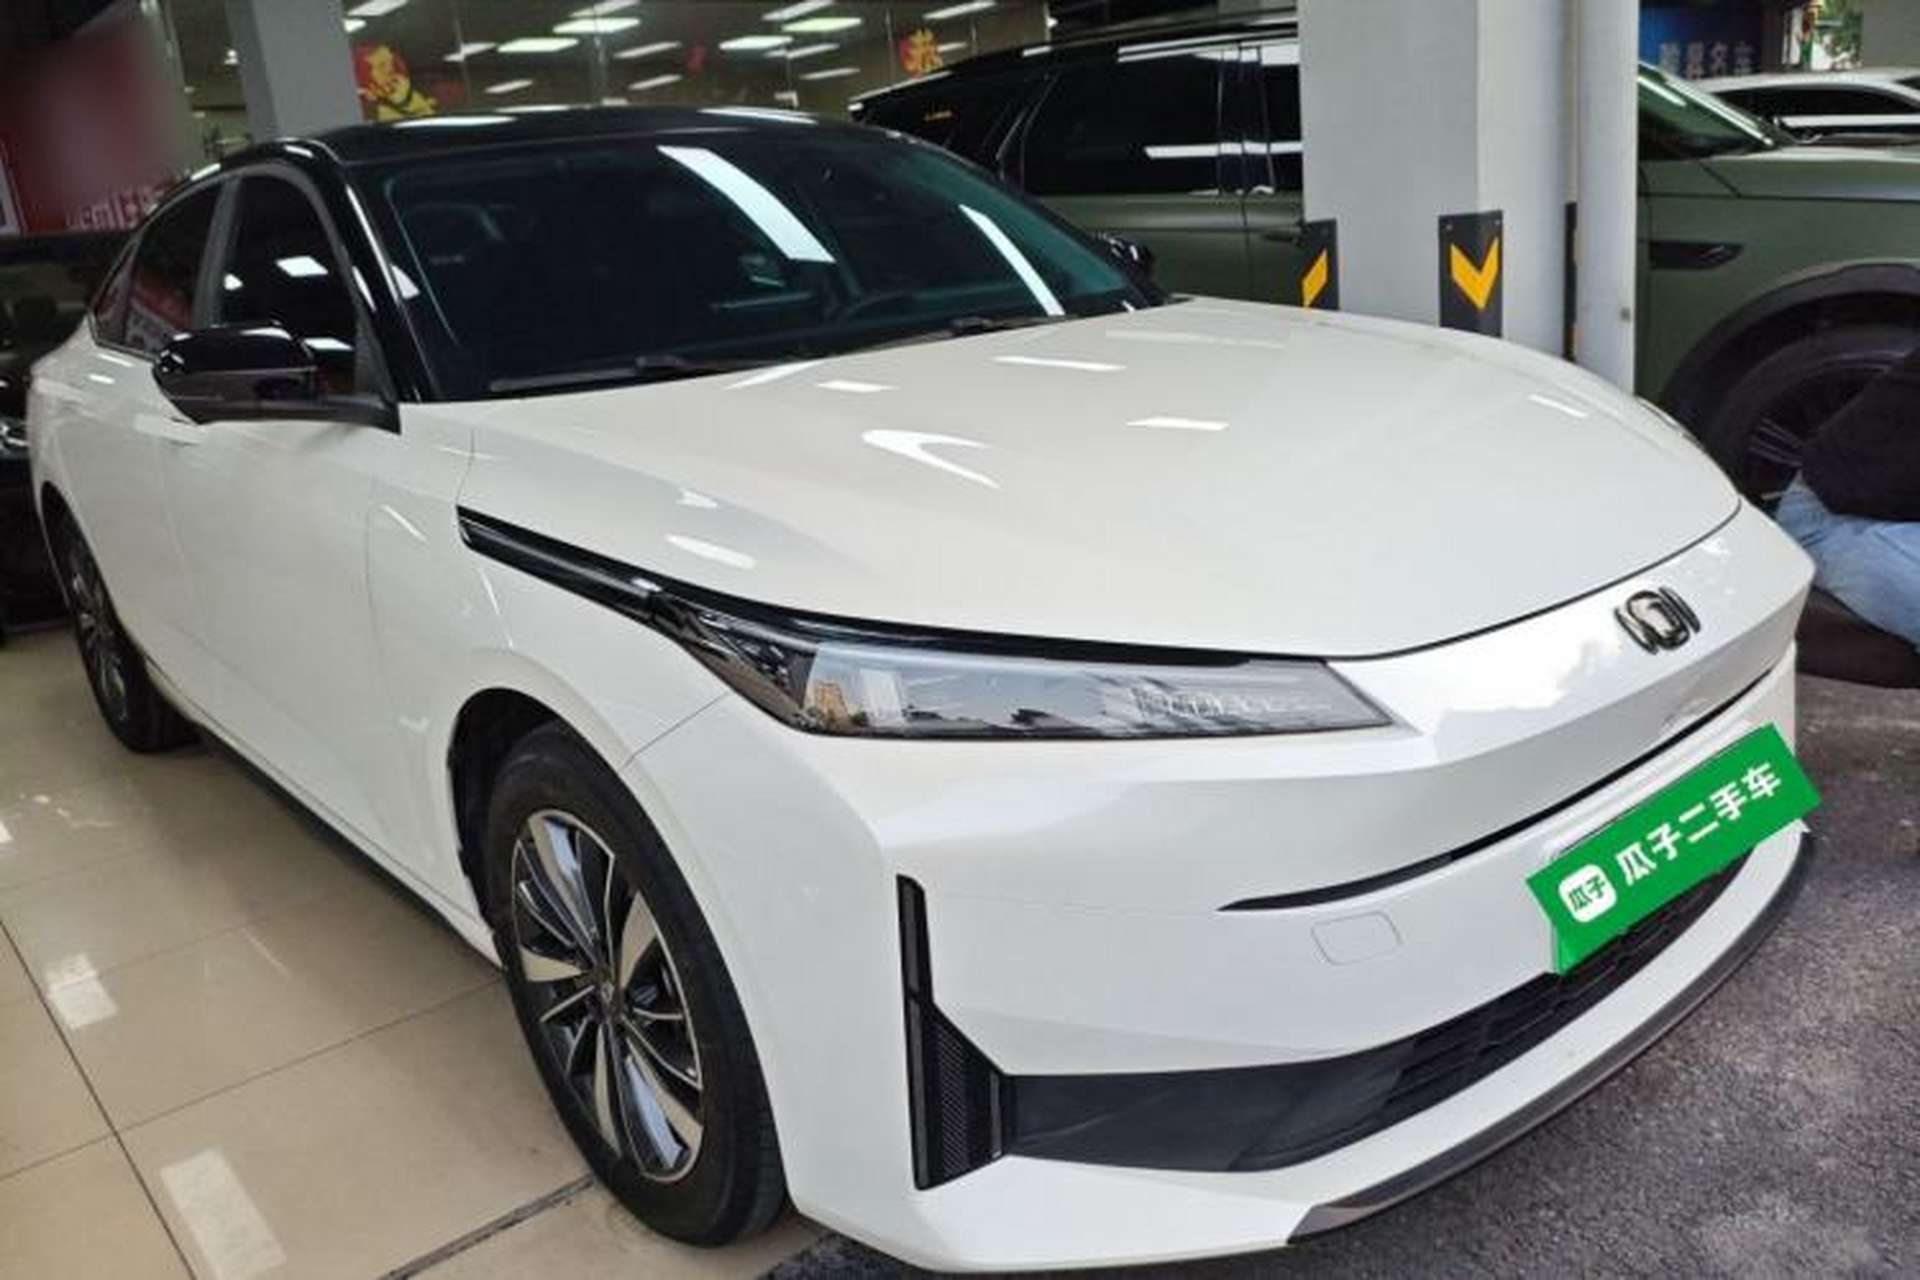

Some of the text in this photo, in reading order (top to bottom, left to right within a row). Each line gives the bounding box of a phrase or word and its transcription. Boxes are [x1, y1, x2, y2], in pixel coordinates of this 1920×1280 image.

[1568, 762, 1781, 912] 瓜子 瓜子二手车
